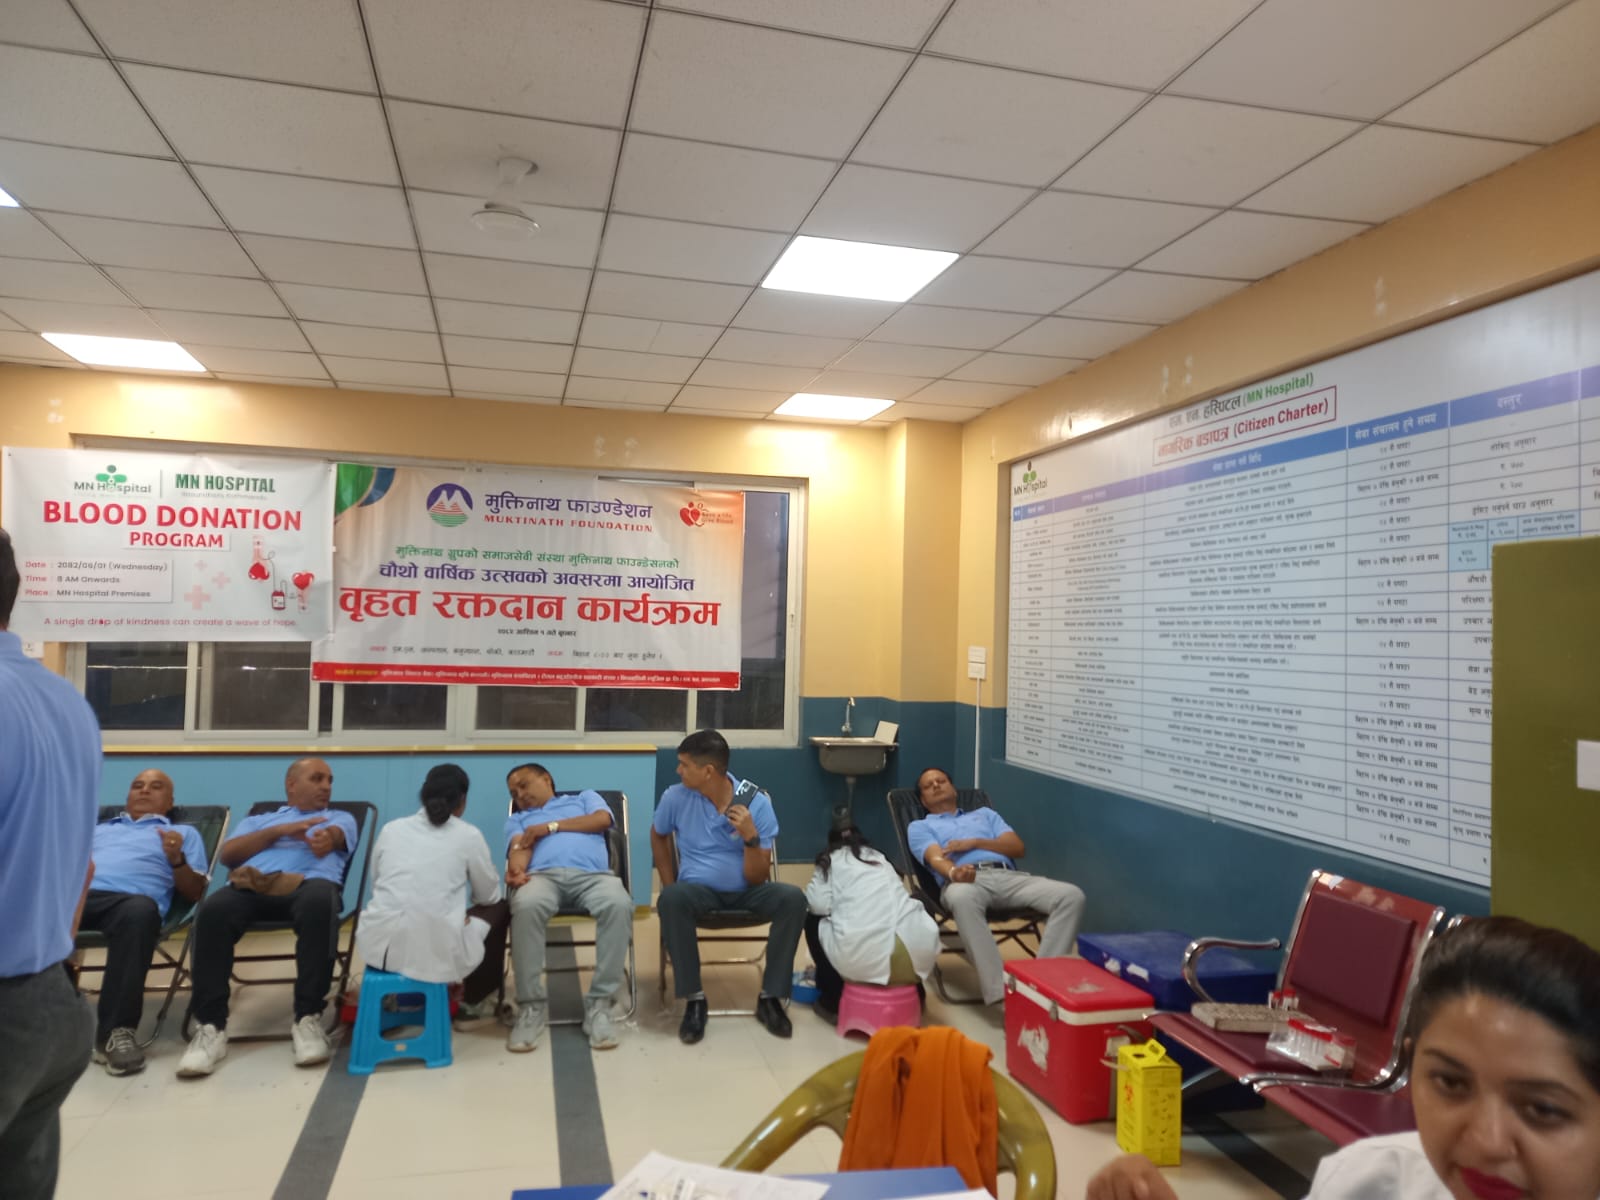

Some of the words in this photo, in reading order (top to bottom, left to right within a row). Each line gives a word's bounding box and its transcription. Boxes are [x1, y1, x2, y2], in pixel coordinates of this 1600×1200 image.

[1242, 388, 1263, 407] (MN
[1265, 372, 1314, 400] Hospital)
[1233, 414, 1275, 439] (Citizen
[1277, 397, 1329, 427] Charter)
[74, 481, 95, 492] MN
[175, 472, 199, 490] MN
[204, 474, 276, 494] HOSPITAL
[43, 500, 147, 526] BLOOD
[156, 505, 302, 531] DONATION
[485, 491, 561, 515] मुक्तिनाथ
[567, 498, 653, 520] फाउण्डेशन
[484, 514, 564, 527] MUKTINATH
[570, 519, 653, 533] FOUNDATION
[129, 531, 223, 549] PROGRAM
[25, 561, 47, 569] Date
[108, 562, 168, 573] (Wednesday)
[395, 545, 443, 559] मुक्तिनाथ
[482, 550, 533, 562] समाजसेवी
[537, 553, 565, 563] संस्था
[568, 553, 613, 567] मुक्तिनाथ
[25, 575, 47, 583] Time
[81, 575, 120, 584] Onwards
[380, 560, 419, 579] चौथो
[424, 563, 476, 581] वार्षिक
[481, 567, 548, 584] उत्सवको
[553, 572, 623, 588] अवसरमा
[627, 574, 695, 591] आयोजित
[25, 589, 48, 597] Place
[56, 589, 71, 597] MN
[73, 589, 109, 598] Hospital
[111, 590, 151, 598] Premises
[339, 587, 420, 622] वृहत
[433, 591, 567, 622] रक्तदान
[577, 593, 721, 626] कार्यक्रम
[44, 617, 51, 625] A
[53, 617, 85, 628] single
[87, 617, 112, 628] drop
[114, 617, 124, 625] of
[126, 617, 170, 626] kindness
[172, 618, 190, 626] can
[193, 618, 224, 626] create
